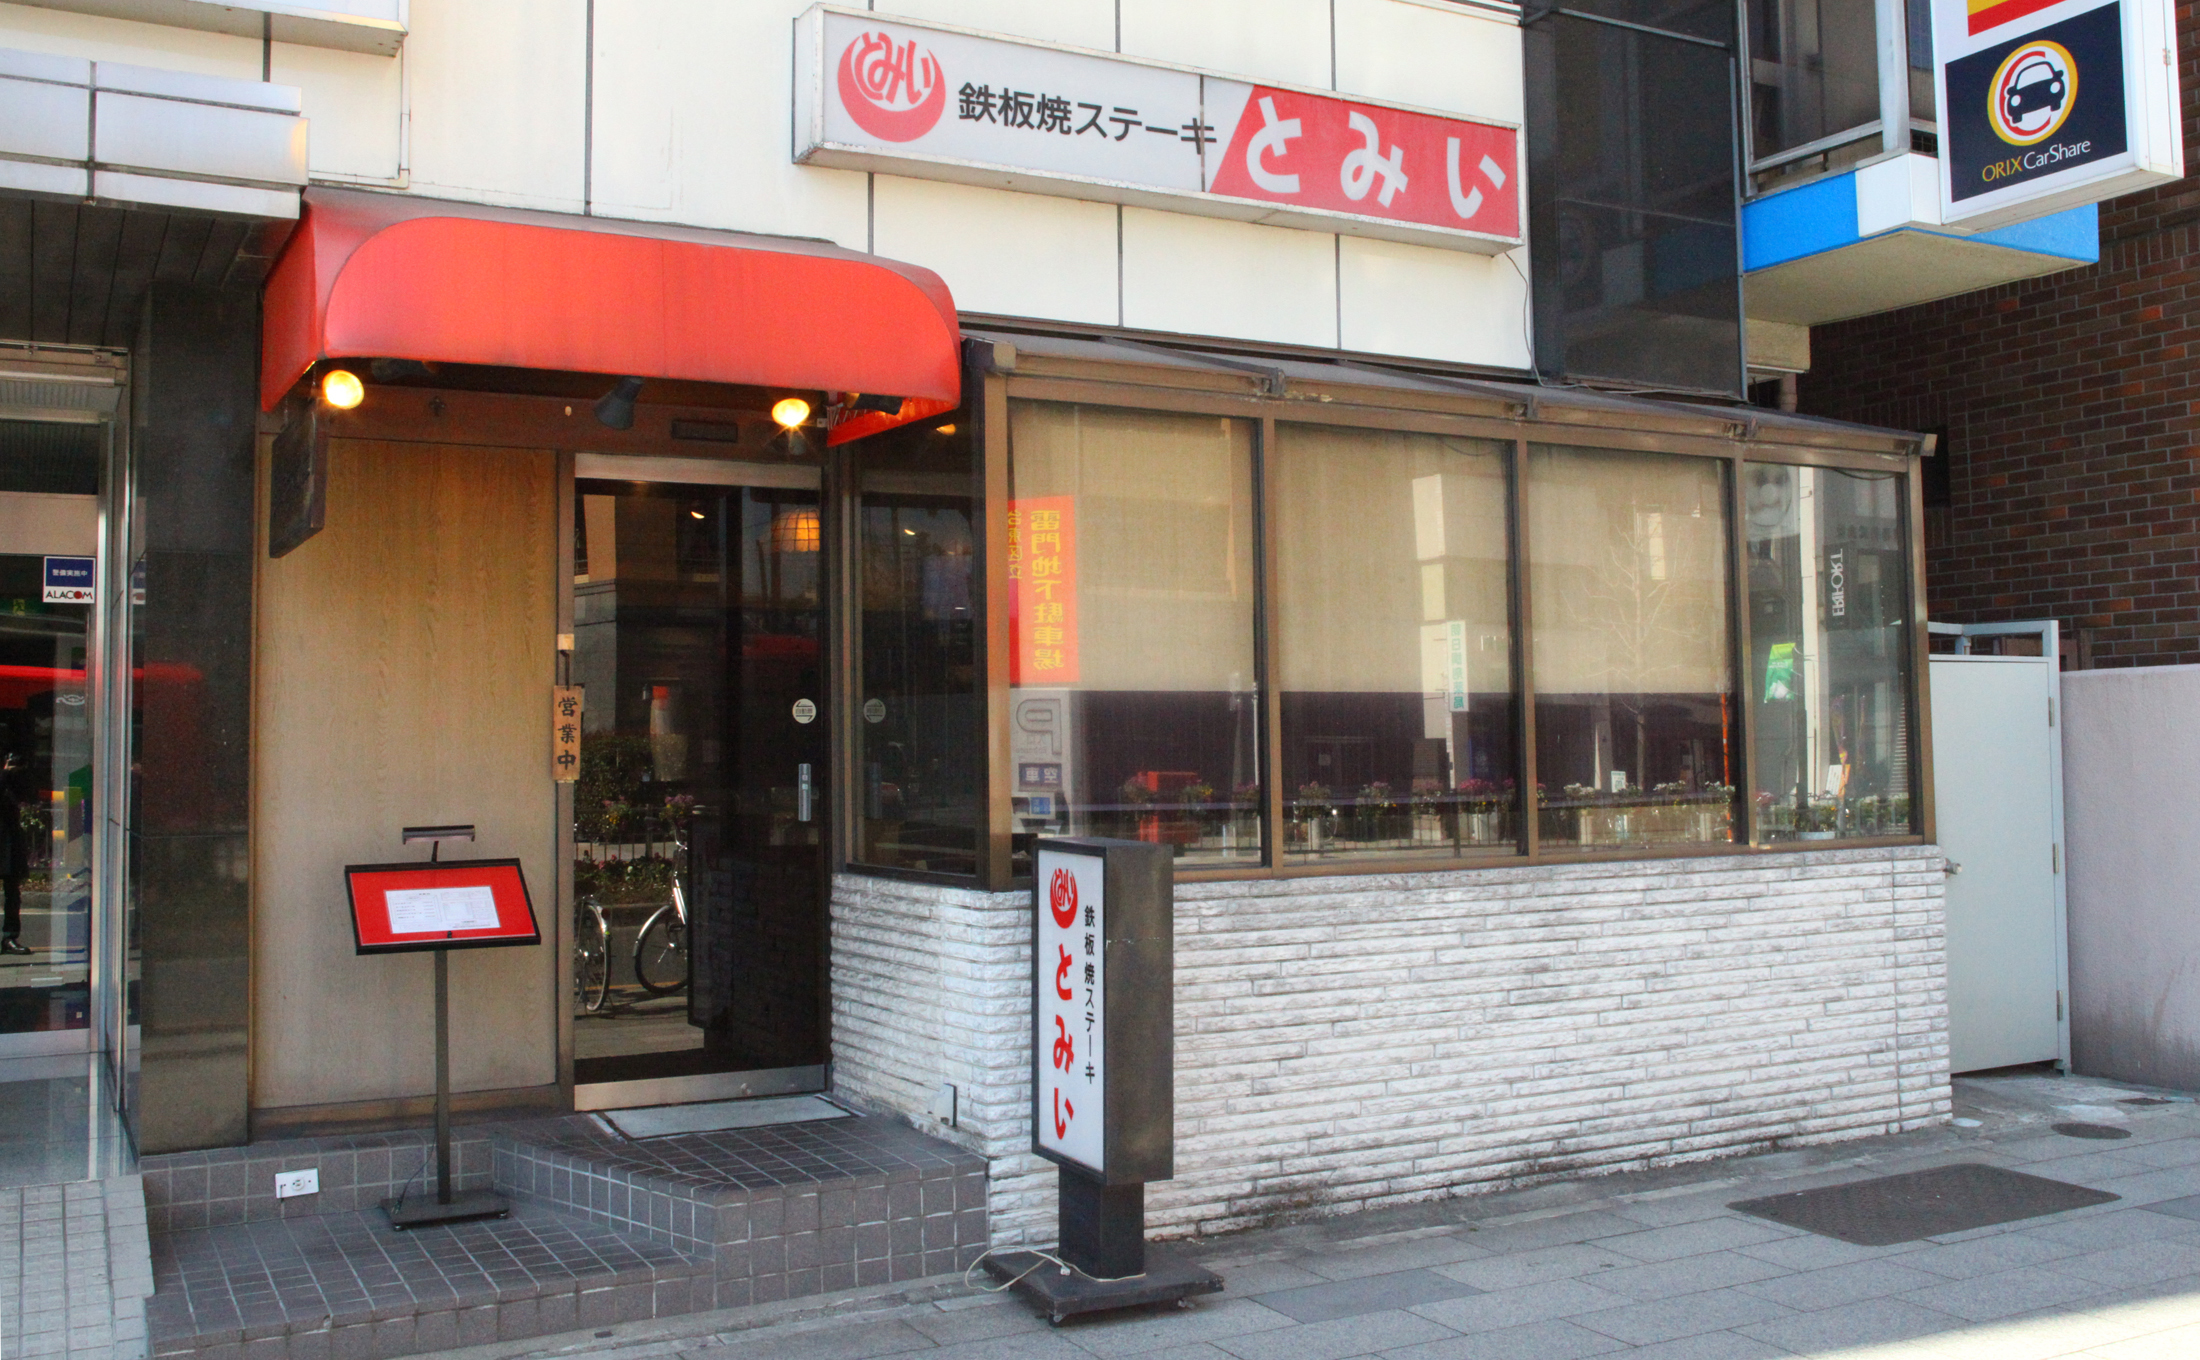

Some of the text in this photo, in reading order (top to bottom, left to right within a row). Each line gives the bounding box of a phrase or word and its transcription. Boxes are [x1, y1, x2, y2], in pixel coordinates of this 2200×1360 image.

[957, 81, 1218, 156] 鉄板焼ステーキ
[1245, 94, 1506, 219] とみい
[1982, 140, 2091, 182] ORIX CarShare
[46, 590, 93, 599] ALACOM
[557, 696, 578, 771] 営業中
[1084, 905, 1096, 1084] 鉄板焼ステーキ
[1053, 943, 1075, 1140] とみい
